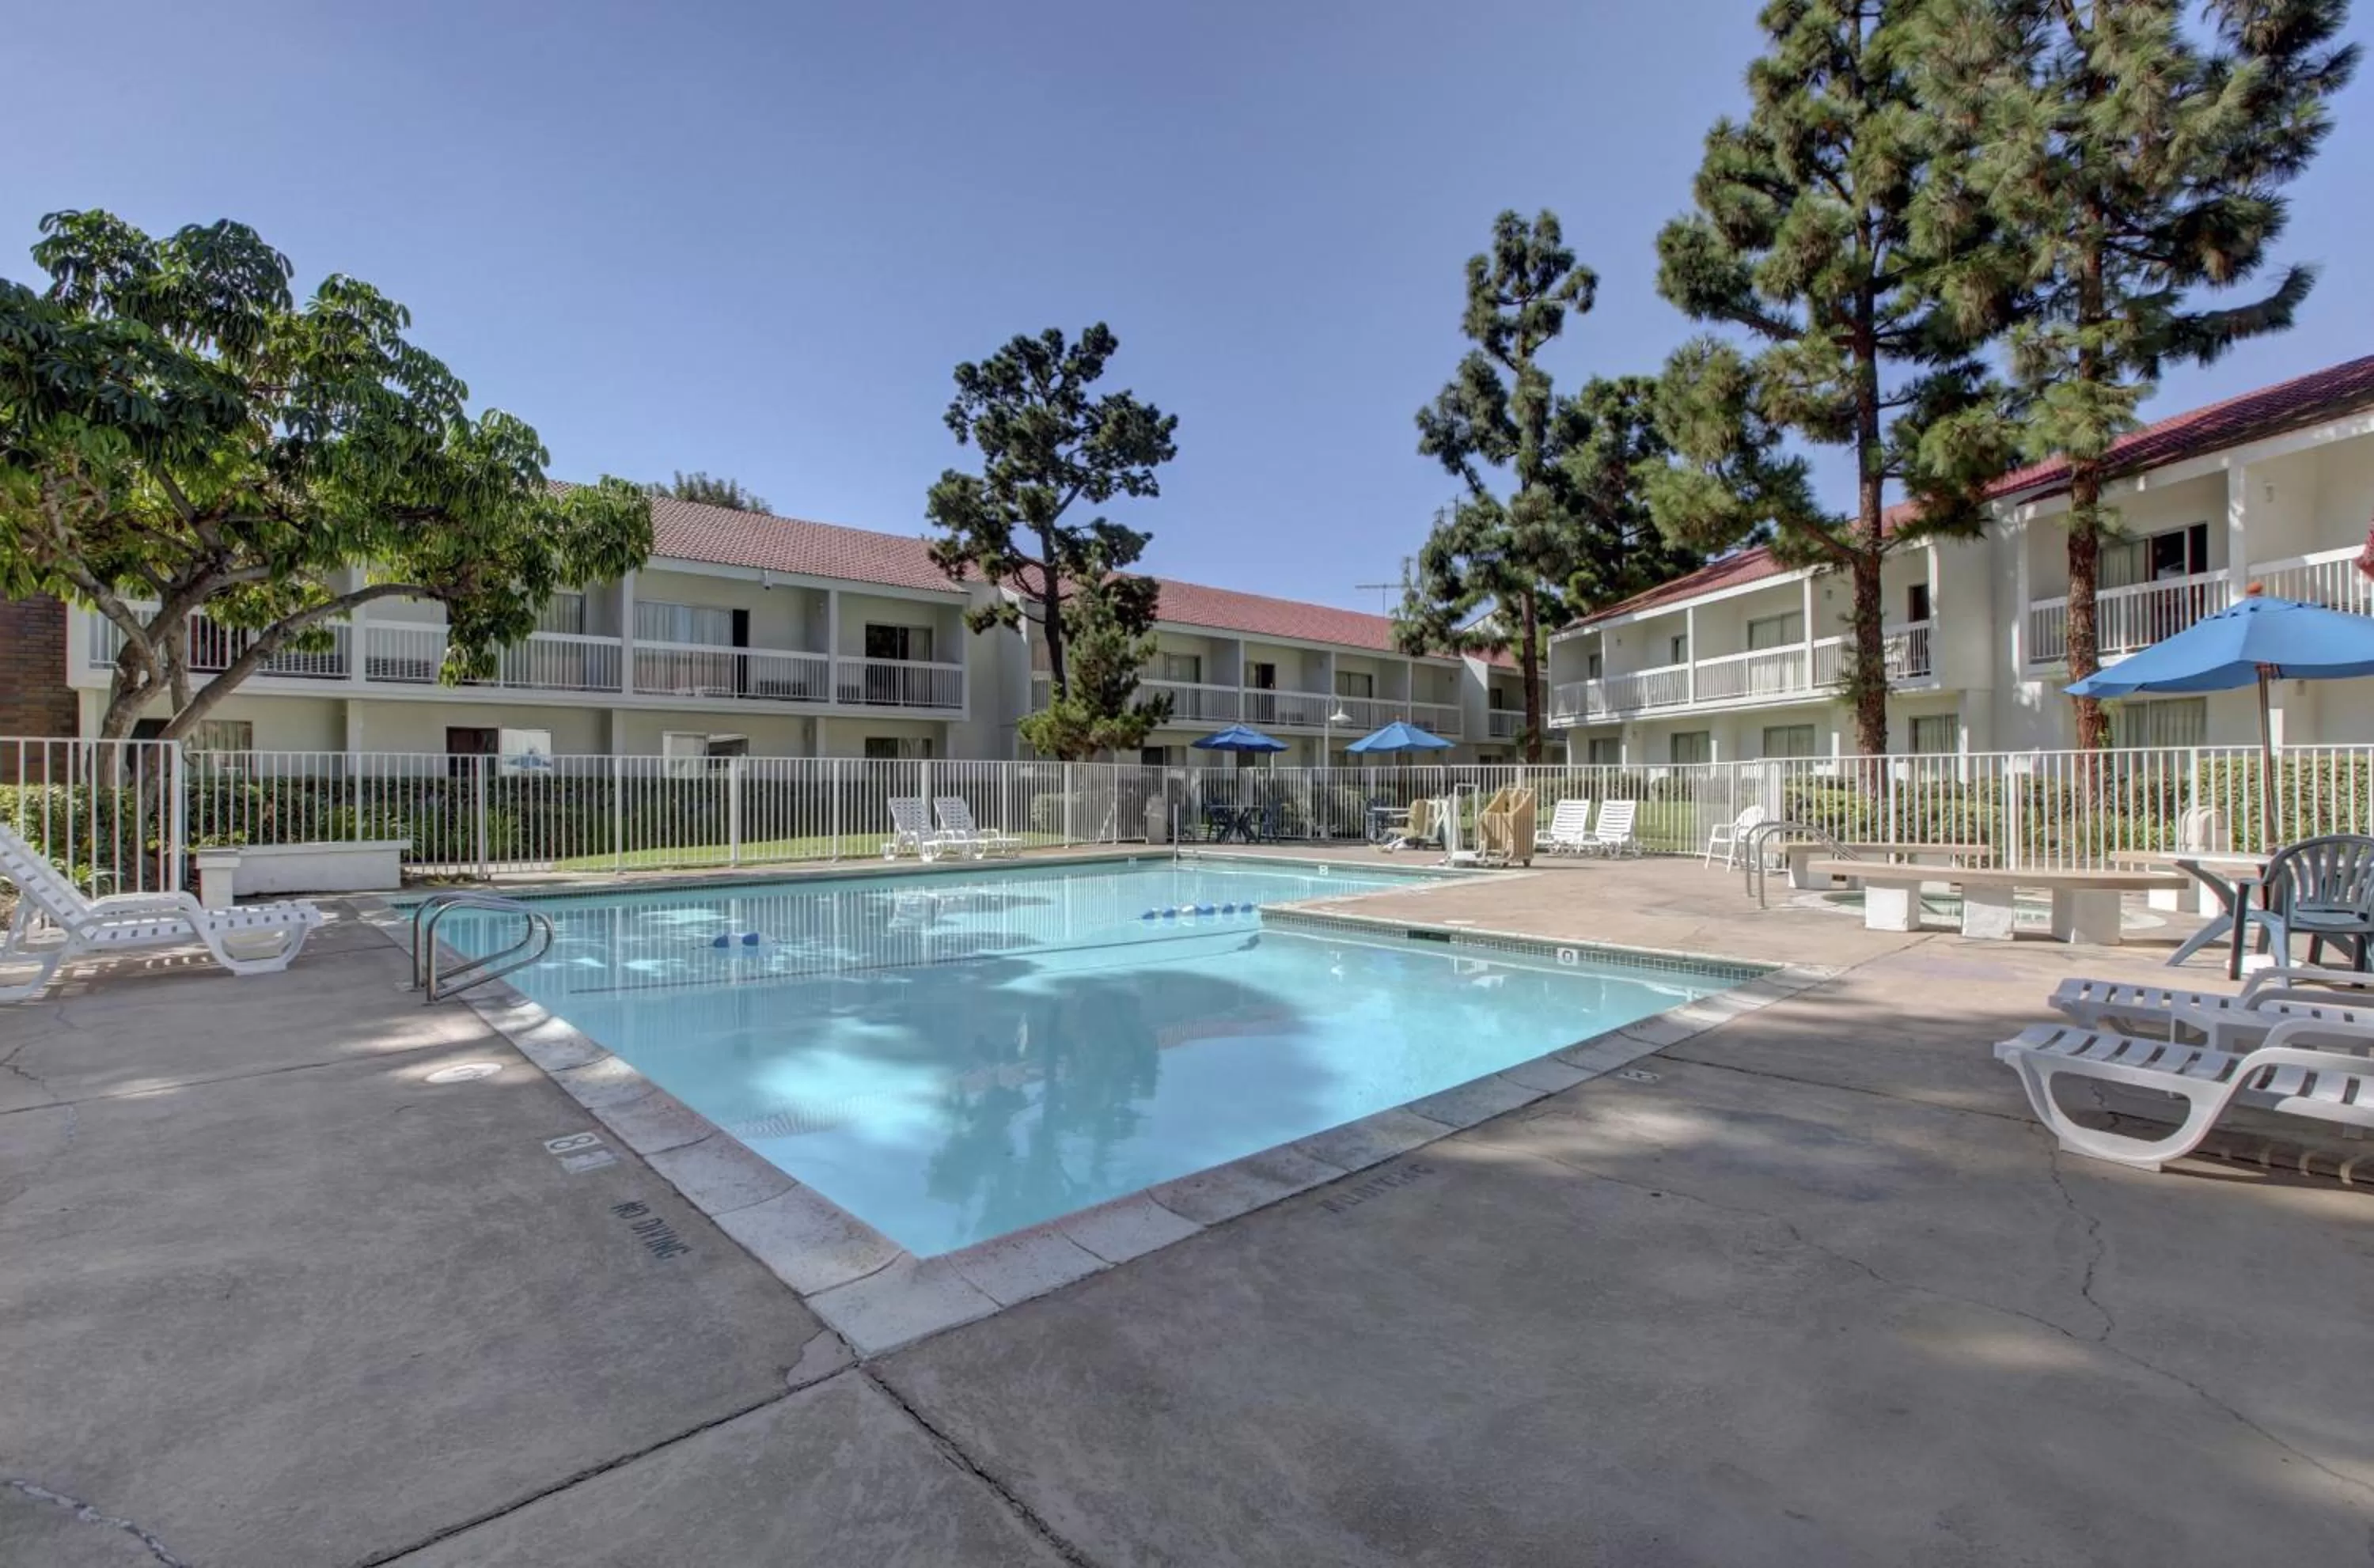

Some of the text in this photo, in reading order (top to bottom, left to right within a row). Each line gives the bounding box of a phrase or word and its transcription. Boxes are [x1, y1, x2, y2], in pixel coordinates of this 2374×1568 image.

[549, 1135, 596, 1149] 8
[611, 1200, 694, 1259] NO DIVING
